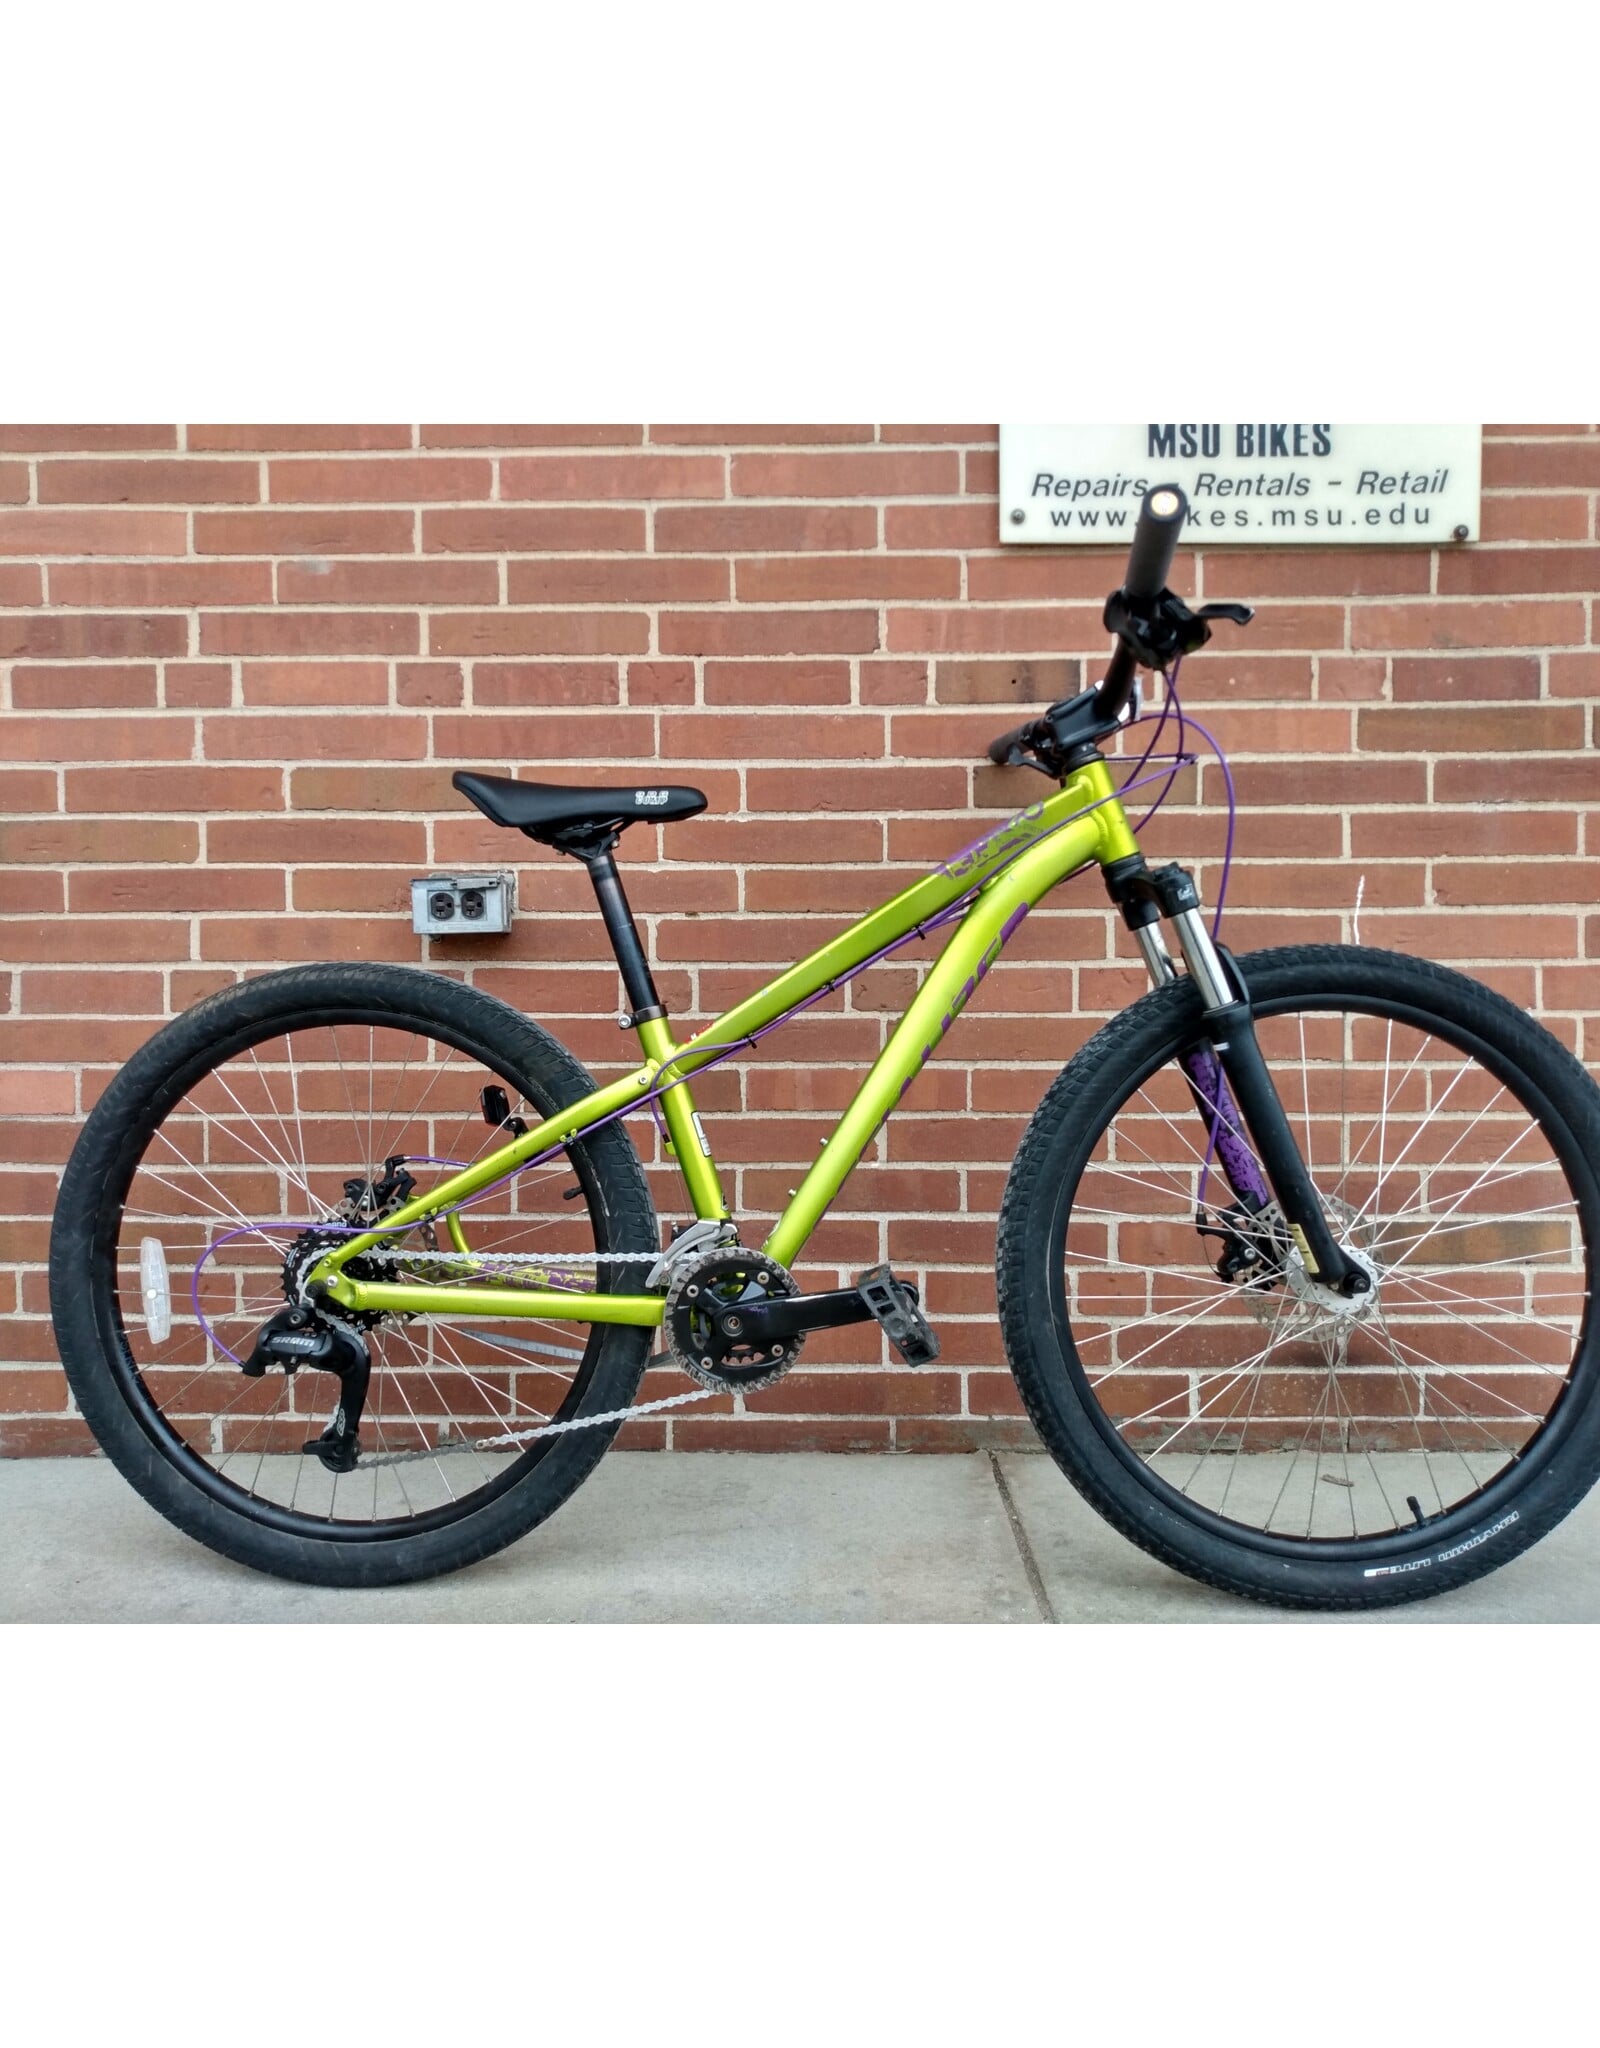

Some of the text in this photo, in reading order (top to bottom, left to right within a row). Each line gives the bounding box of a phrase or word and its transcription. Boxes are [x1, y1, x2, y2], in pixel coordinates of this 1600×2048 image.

[1148, 424, 1331, 458] MSU BIKES
[1031, 472, 1149, 502] Repairs
[1194, 471, 1310, 496] Rentals
[1356, 468, 1449, 495] Retail
[1051, 502, 1430, 527] www.kes.msu.edu
